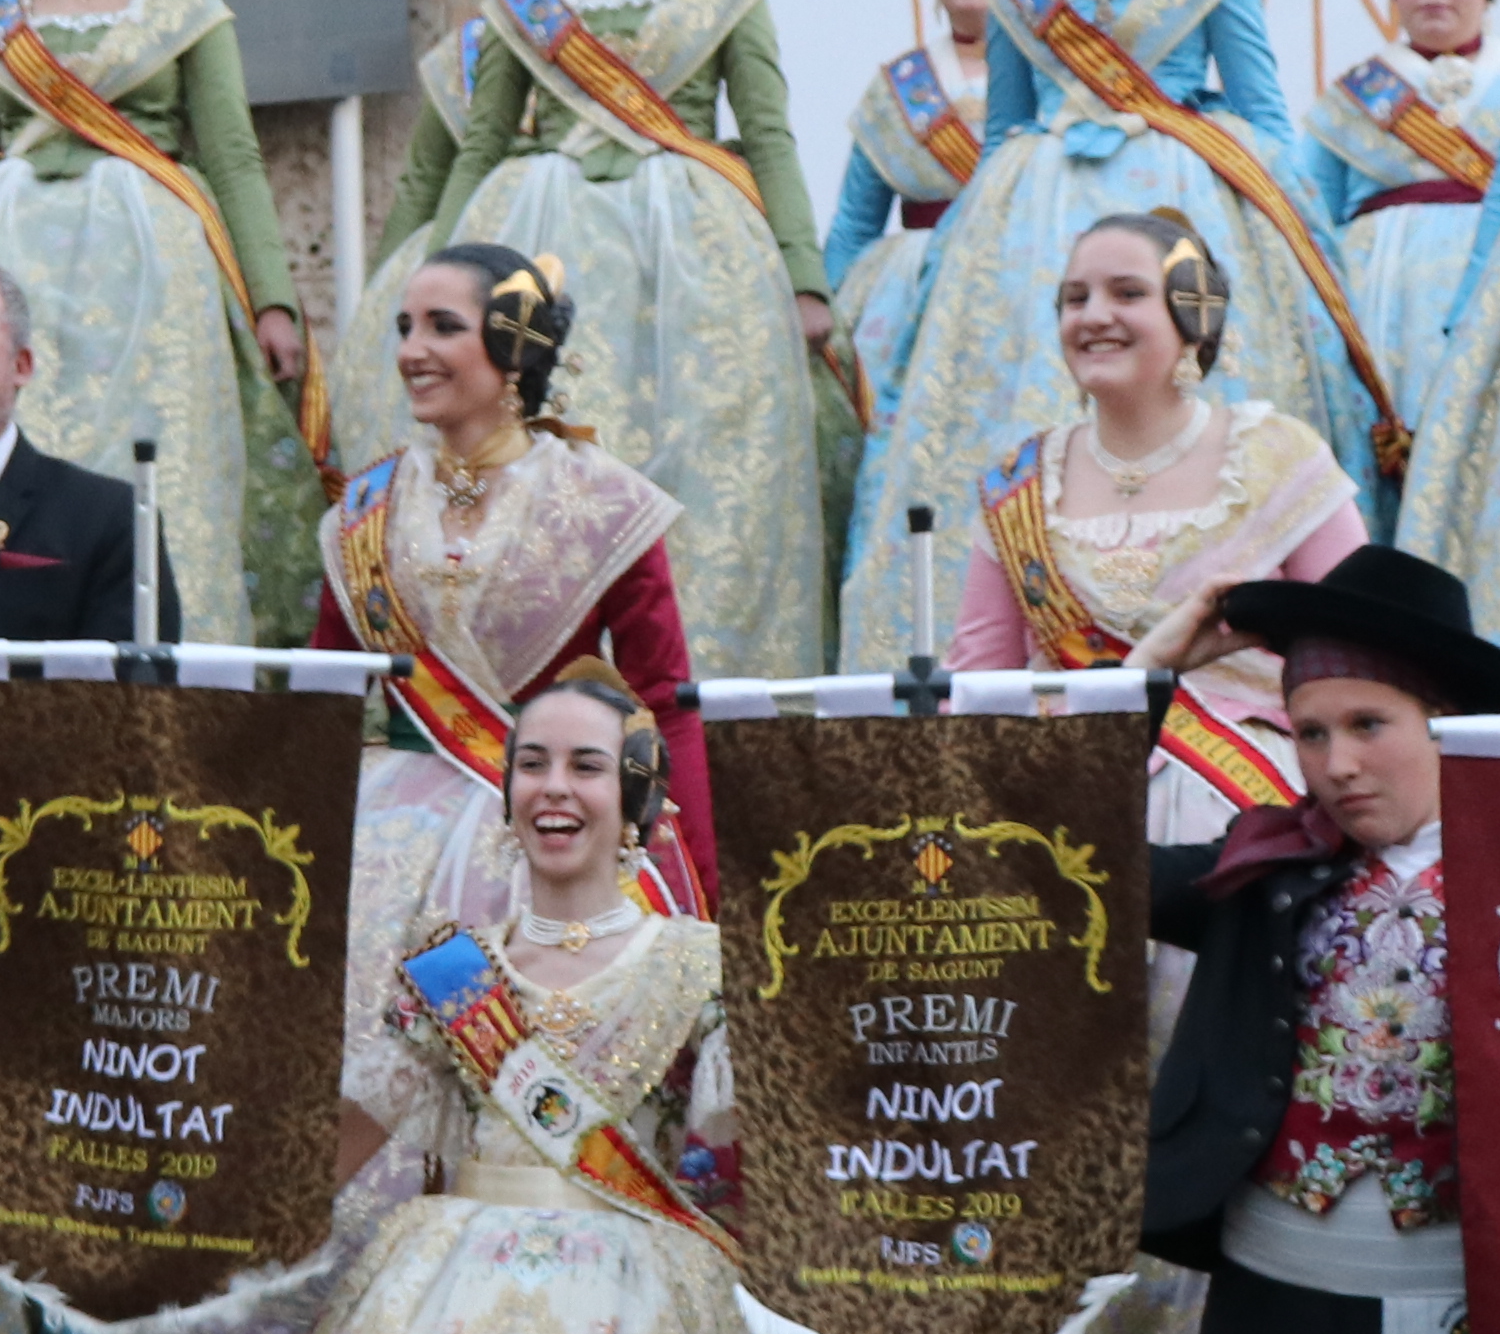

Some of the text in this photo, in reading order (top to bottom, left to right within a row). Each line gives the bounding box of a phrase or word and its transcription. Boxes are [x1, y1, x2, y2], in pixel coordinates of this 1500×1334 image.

[36, 890, 264, 930] AJUNTAMENT
[86, 928, 212, 955] DE SAGUNT
[813, 920, 1058, 958] AJUNTAMENT
[72, 962, 221, 1014] PREMI
[867, 958, 1005, 983] DE SAGUNT
[92, 1004, 191, 1032] MAJORS
[849, 993, 1019, 1044] PREMI
[82, 1037, 207, 1085] NINOT
[868, 1037, 999, 1065] INFANTILS
[509, 1058, 537, 1097] 2019
[43, 1088, 234, 1144] INDULTAT
[866, 1077, 1005, 1123] NINOT
[48, 1134, 218, 1179] FALLES 2019
[824, 1138, 1039, 1184] INDULTAT
[75, 1182, 135, 1215] FJFS
[839, 1189, 1023, 1222] FALLES 2019
